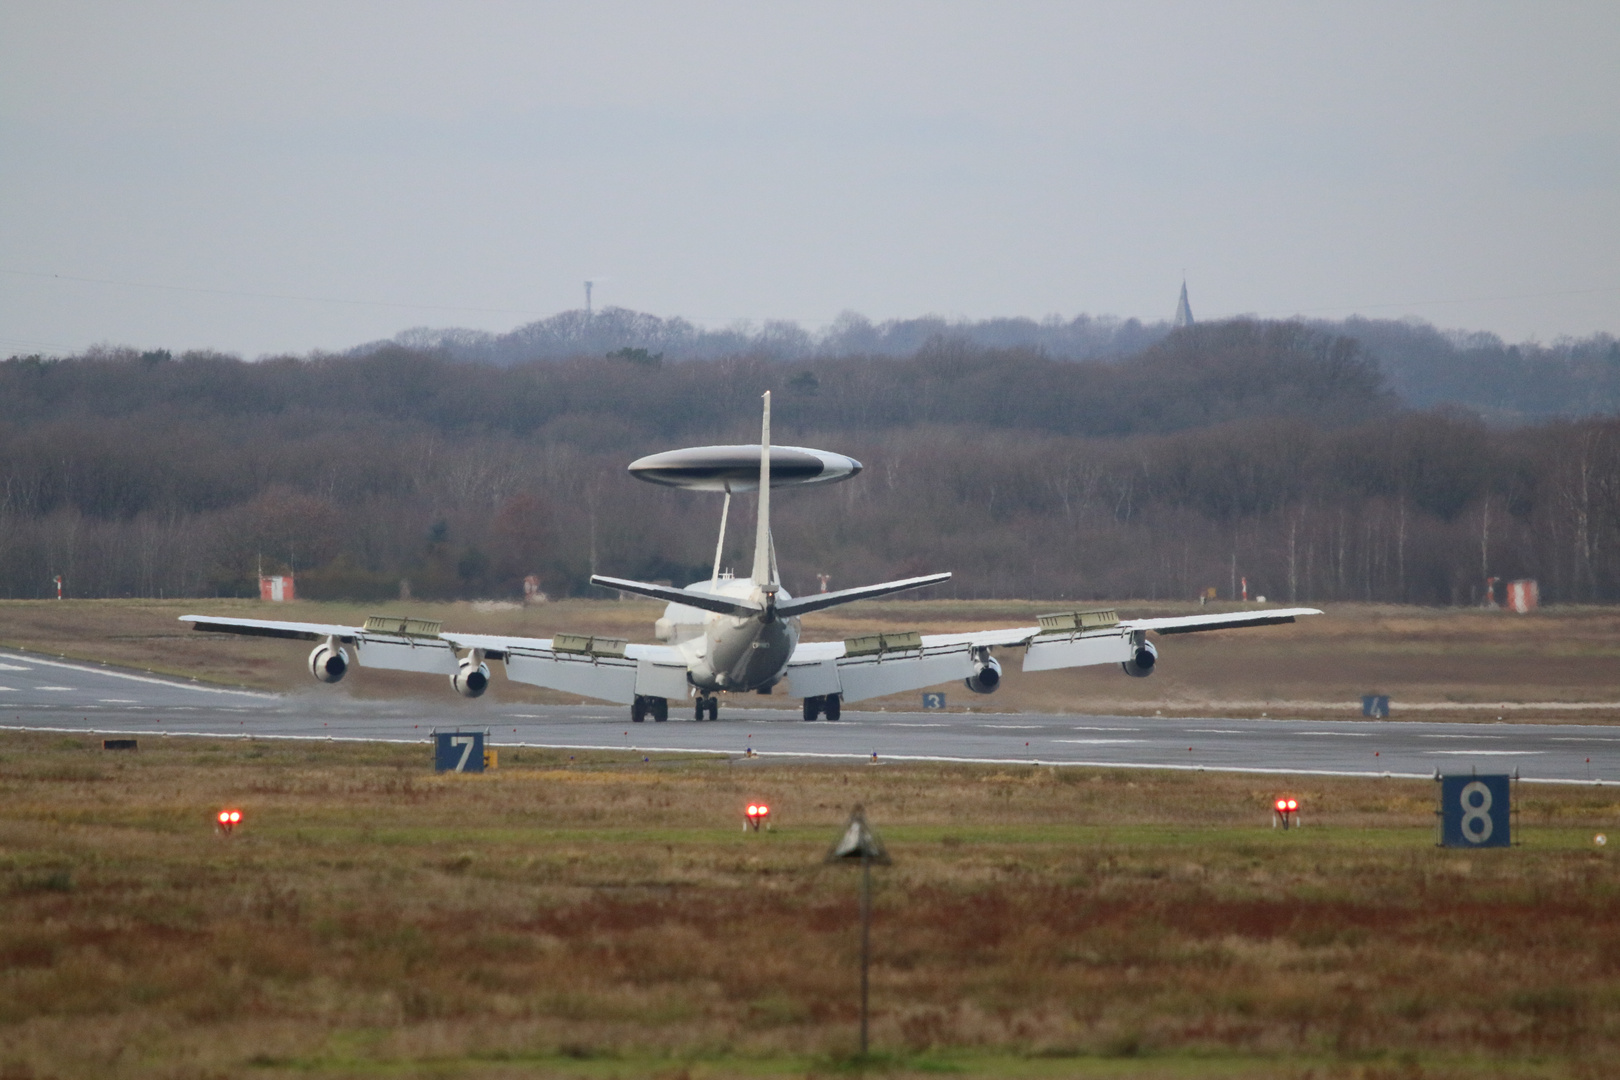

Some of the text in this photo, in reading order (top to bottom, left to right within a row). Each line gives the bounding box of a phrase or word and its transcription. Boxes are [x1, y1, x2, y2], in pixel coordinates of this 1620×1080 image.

[928, 694, 940, 709] 3
[1370, 697, 1382, 716] 4
[451, 736, 474, 773] 7
[1460, 781, 1493, 843] 8
